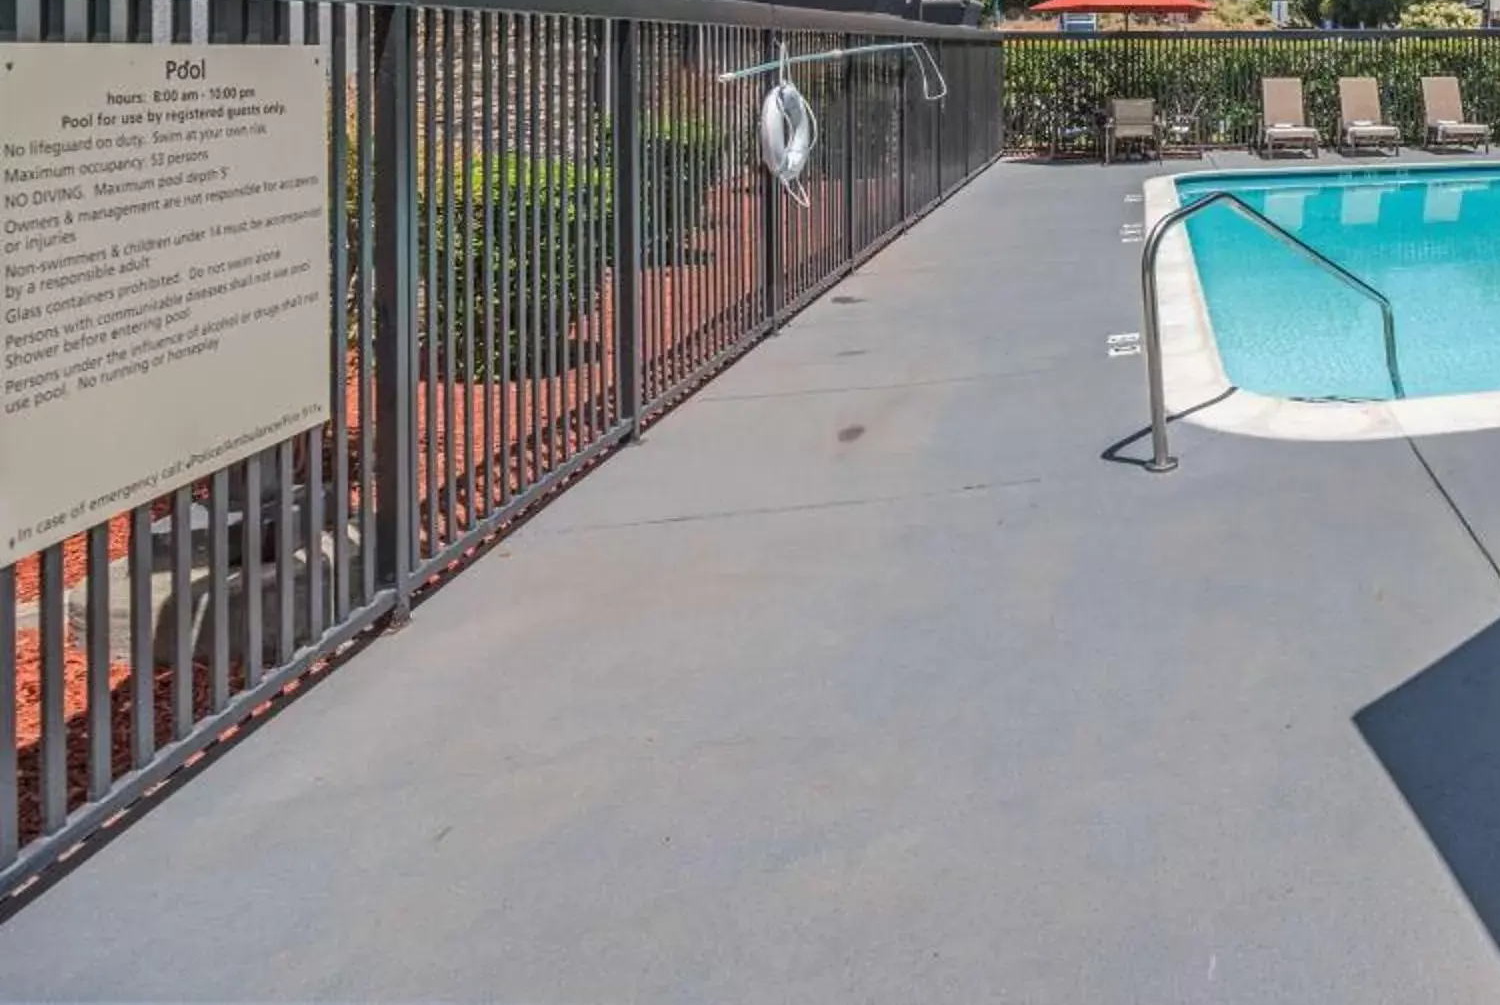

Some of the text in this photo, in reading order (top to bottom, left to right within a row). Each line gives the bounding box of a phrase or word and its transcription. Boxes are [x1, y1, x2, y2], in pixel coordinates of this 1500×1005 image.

[166, 59, 205, 80] Pool
[181, 91, 198, 101] am
[239, 88, 255, 100] pm
[62, 112, 93, 128] Pool
[97, 111, 116, 126] for
[121, 113, 142, 125] use
[147, 110, 163, 125] by
[165, 107, 223, 124] registered
[227, 104, 260, 120] guests
[4, 142, 26, 157] No
[29, 137, 92, 157] lifeguard
[96, 138, 112, 150] on
[186, 130, 199, 141] at
[4, 164, 75, 183] Maximum
[5, 192, 28, 208] NO
[94, 177, 155, 196] Maximum
[158, 173, 182, 188] pool
[4, 216, 60, 235] Owners
[64, 210, 74, 225] &
[78, 199, 160, 222] management
[163, 197, 182, 210] are
[184, 192, 203, 206] not
[4, 231, 77, 254] or injuries
[5, 250, 107, 278] Non-swimmers
[111, 244, 120, 258] &
[5, 256, 150, 301] by a responsible adult
[5, 305, 42, 325] Glass
[45, 290, 115, 315] containers
[5, 326, 60, 349] Persons
[63, 316, 93, 336] with
[5, 343, 60, 371] Shower
[63, 330, 108, 354] before
[111, 315, 163, 340] entering
[5, 369, 60, 395] Persons
[63, 355, 104, 378] under
[106, 348, 128, 365] the
[5, 397, 31, 415] use
[77, 374, 98, 391] No
[100, 359, 150, 382] running
[36, 512, 67, 535] case
[70, 503, 87, 519] of
[89, 474, 159, 513] emergency
